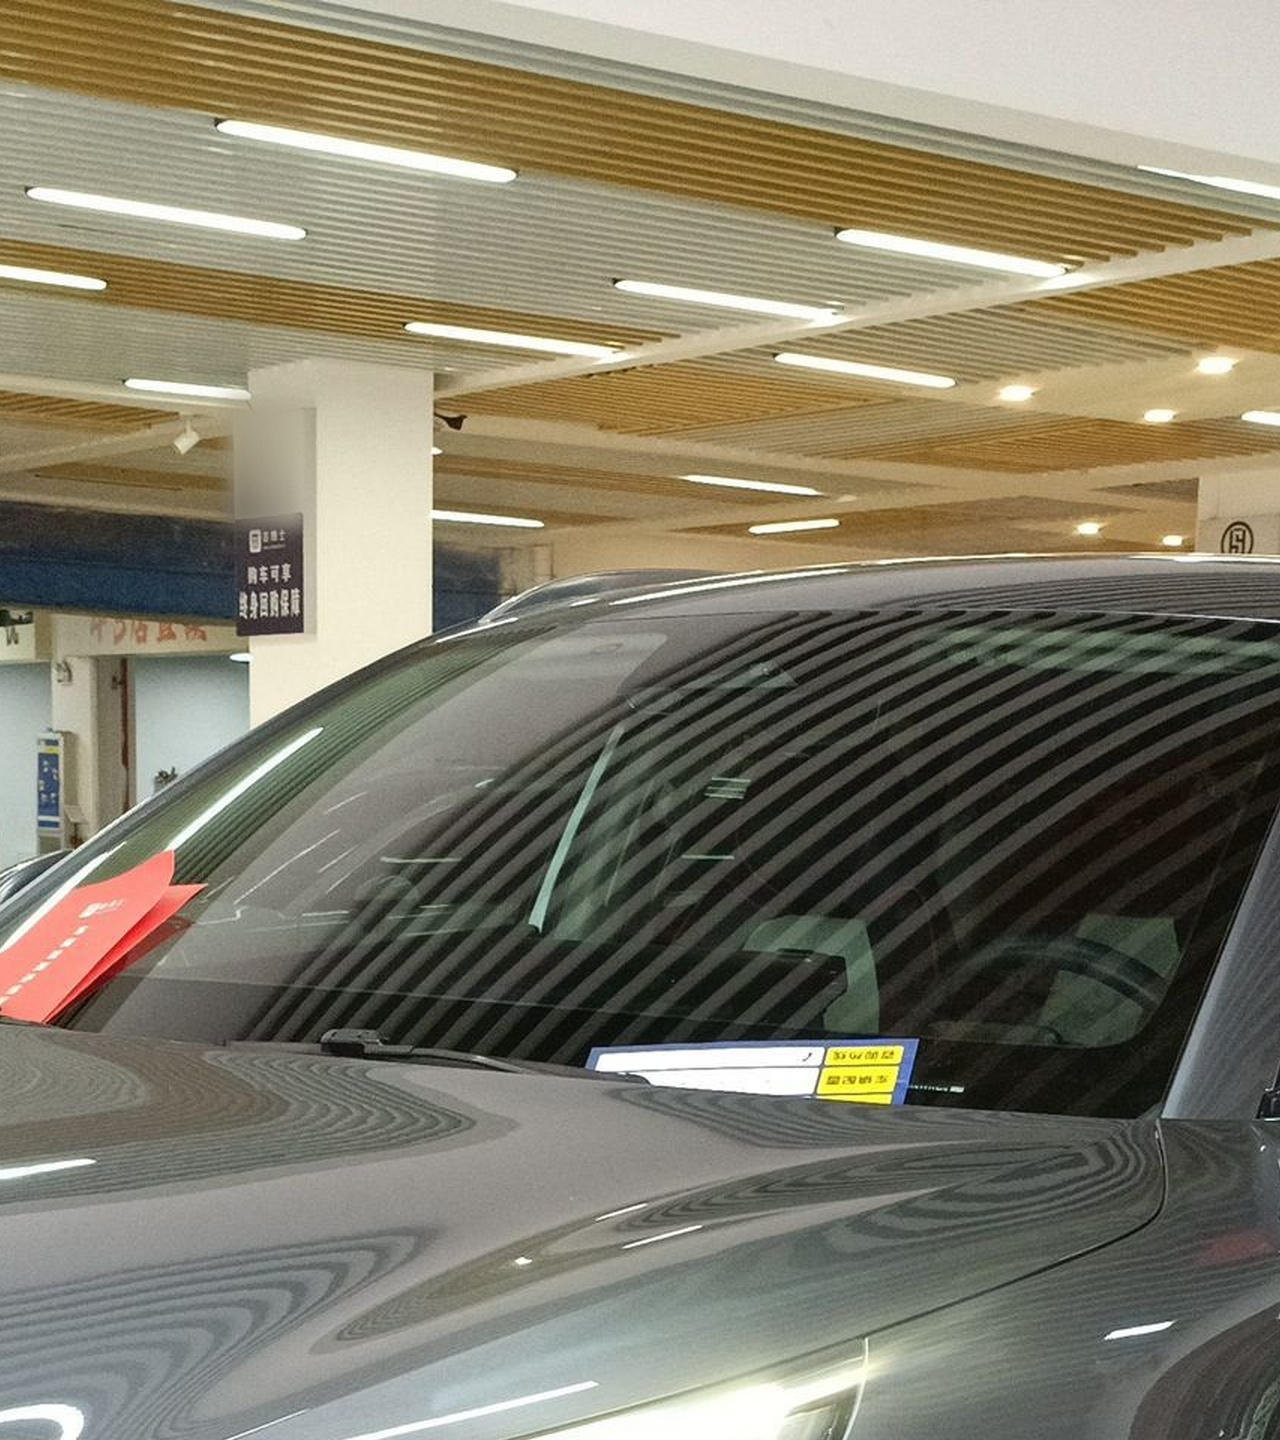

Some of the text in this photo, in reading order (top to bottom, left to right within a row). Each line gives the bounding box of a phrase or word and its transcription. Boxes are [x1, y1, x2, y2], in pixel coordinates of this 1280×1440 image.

[247, 563, 291, 585] 购车可享
[239, 587, 301, 619] 终身回购保障
